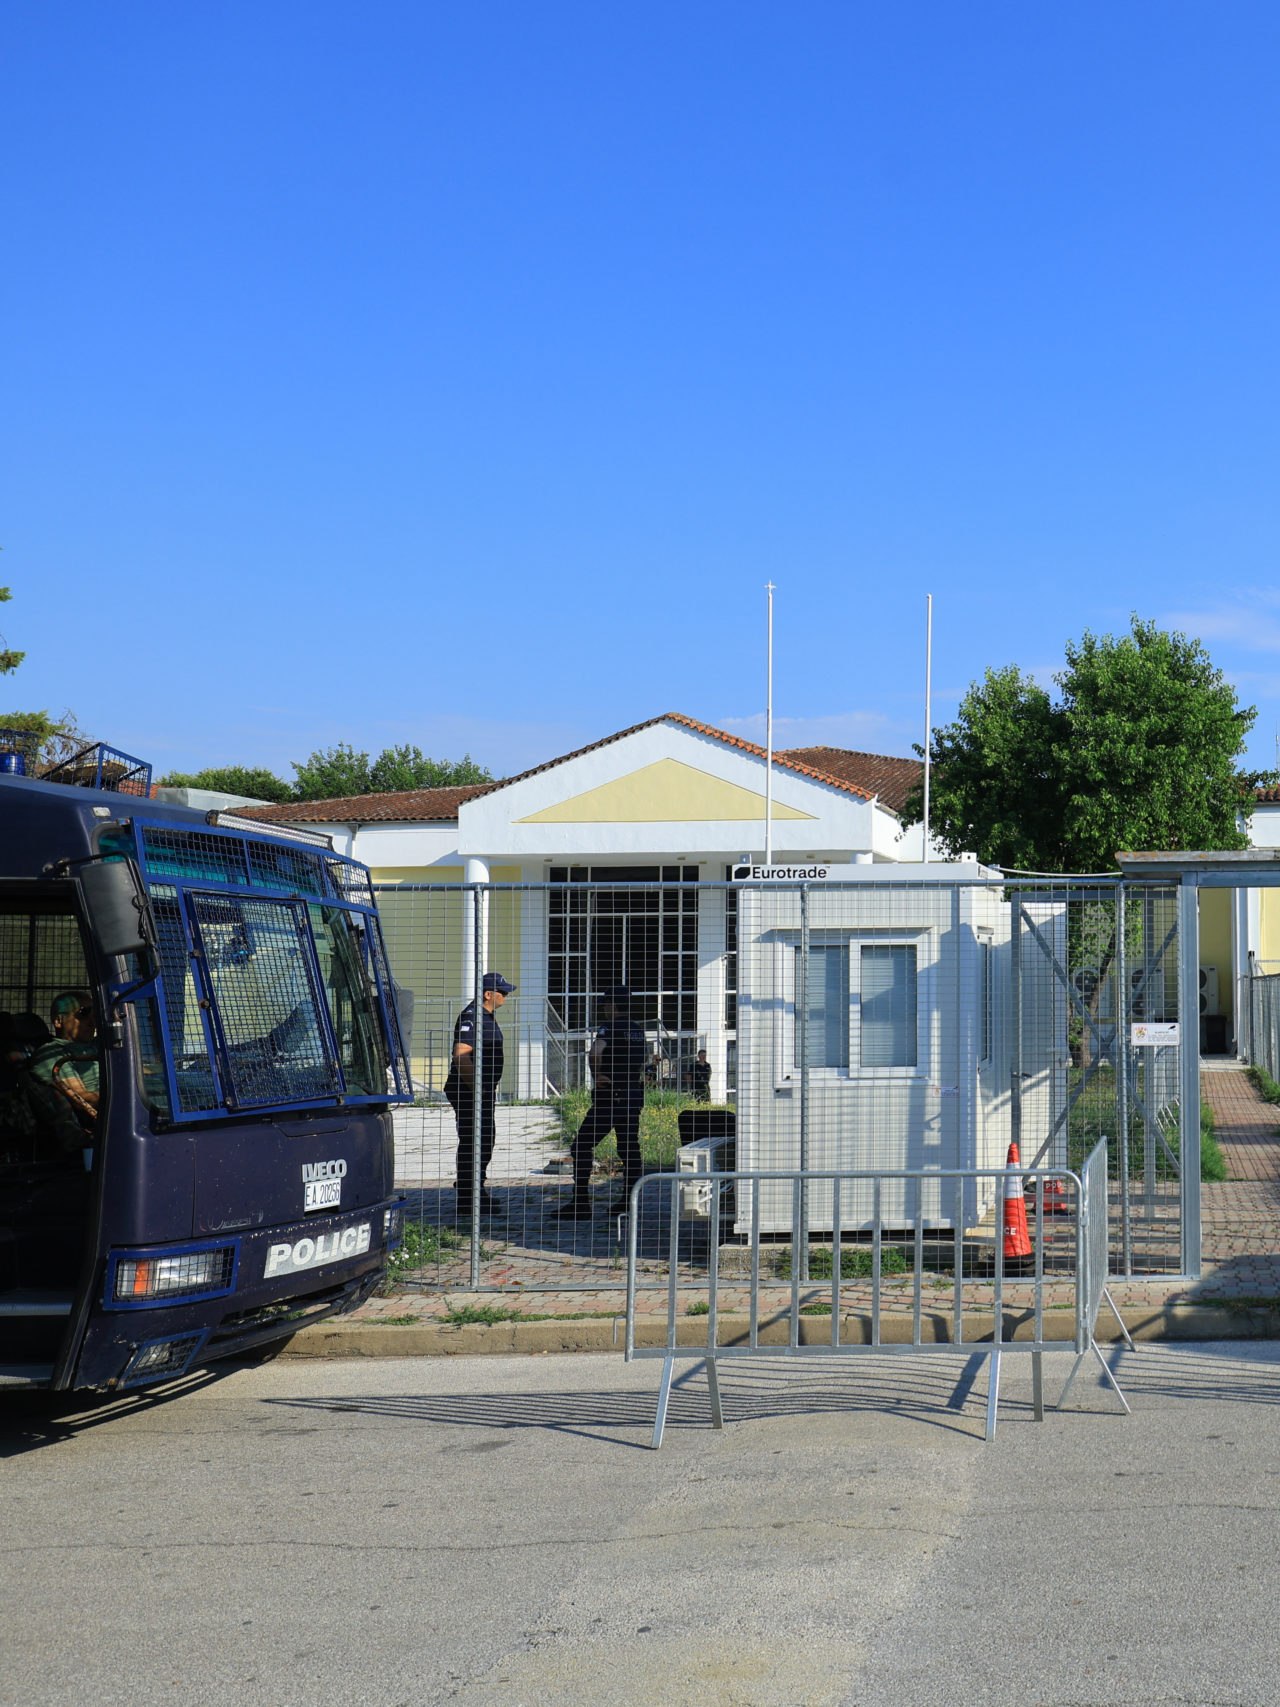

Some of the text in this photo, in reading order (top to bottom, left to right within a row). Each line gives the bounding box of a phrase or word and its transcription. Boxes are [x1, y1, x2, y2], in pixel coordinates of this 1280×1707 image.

[752, 866, 827, 879] Eurotrade
[302, 1159, 347, 1183] IVECO
[268, 1223, 371, 1272] POLICE
